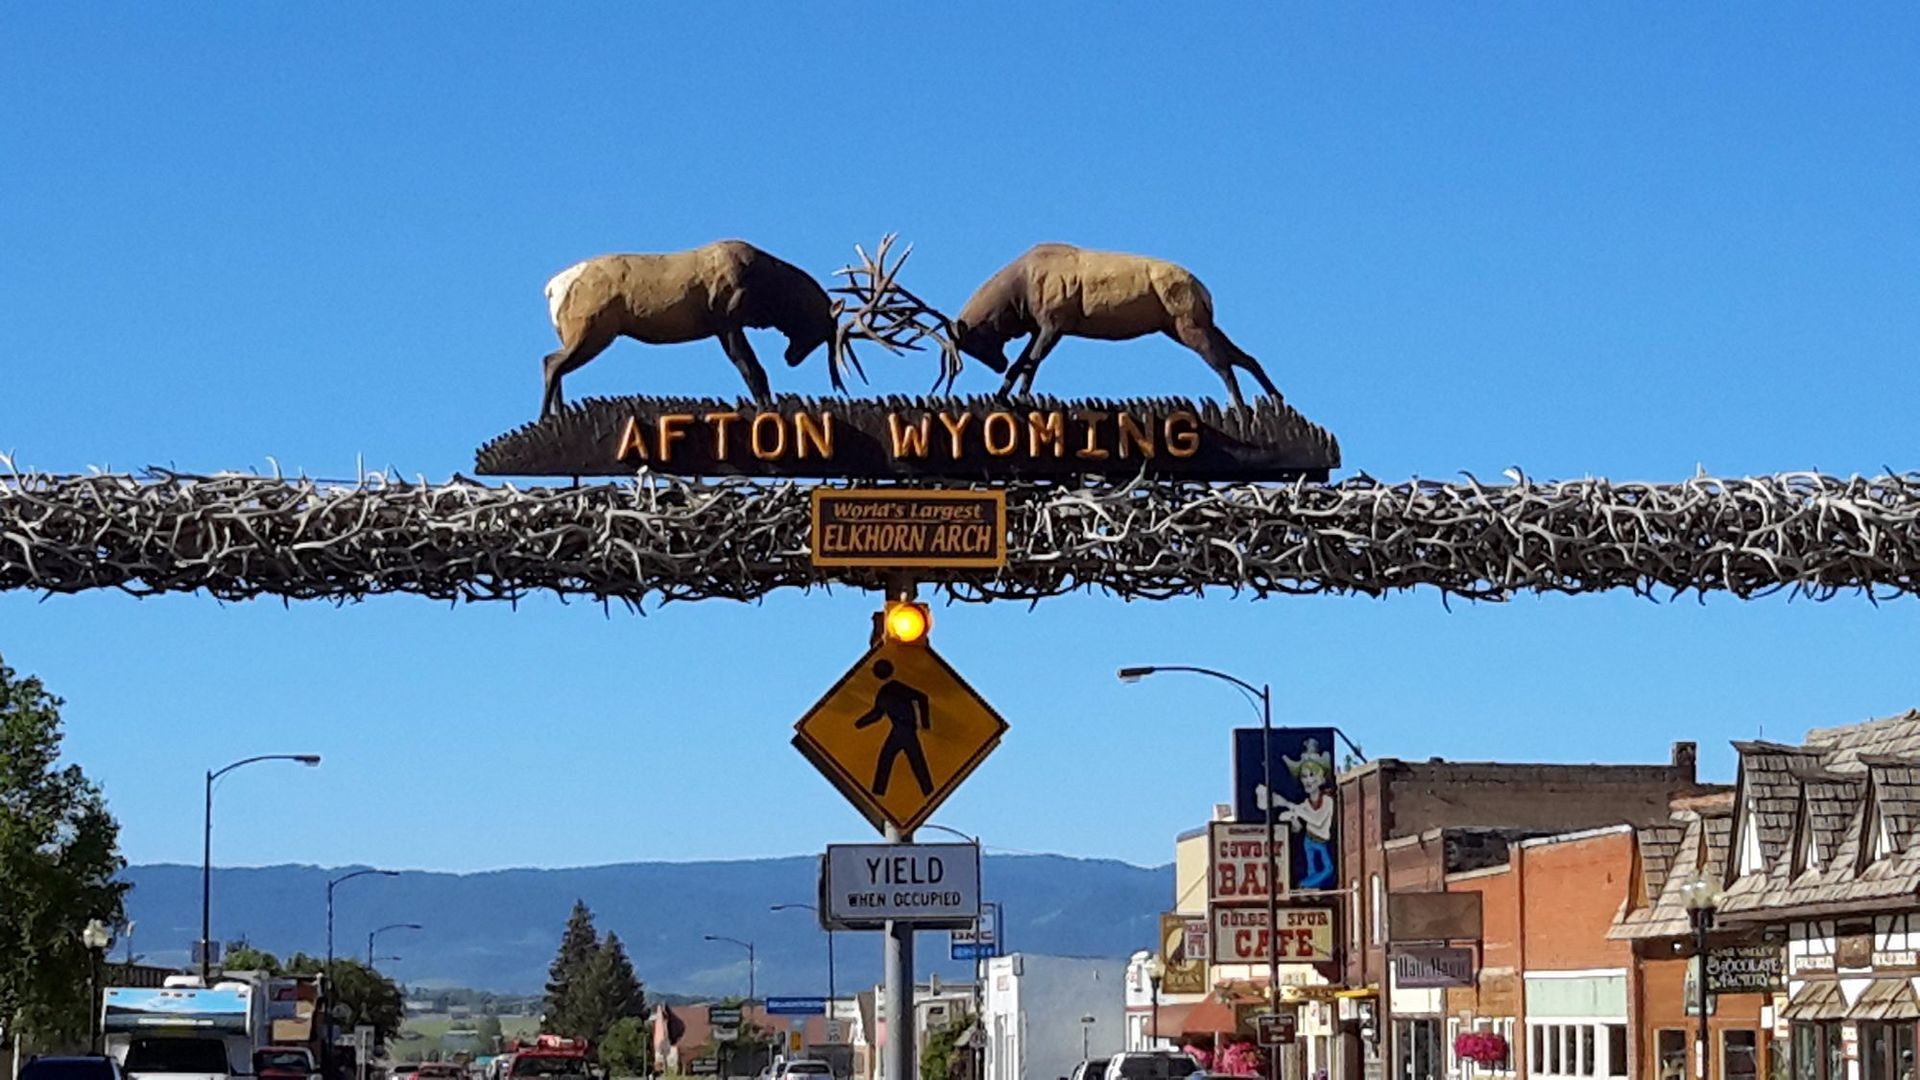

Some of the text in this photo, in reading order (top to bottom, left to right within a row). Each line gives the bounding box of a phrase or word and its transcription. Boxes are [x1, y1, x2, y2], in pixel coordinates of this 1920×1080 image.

[617, 411, 1200, 462] AFTON WYOMING
[833, 503, 983, 519] World's Largest
[823, 523, 992, 552] ELKHORN ARCH
[867, 857, 944, 884] YIELD
[848, 892, 962, 907] WHEN OCCUPIED
[1221, 912, 1329, 927] GOLDE SPUR
[1235, 929, 1313, 958] CAFE
